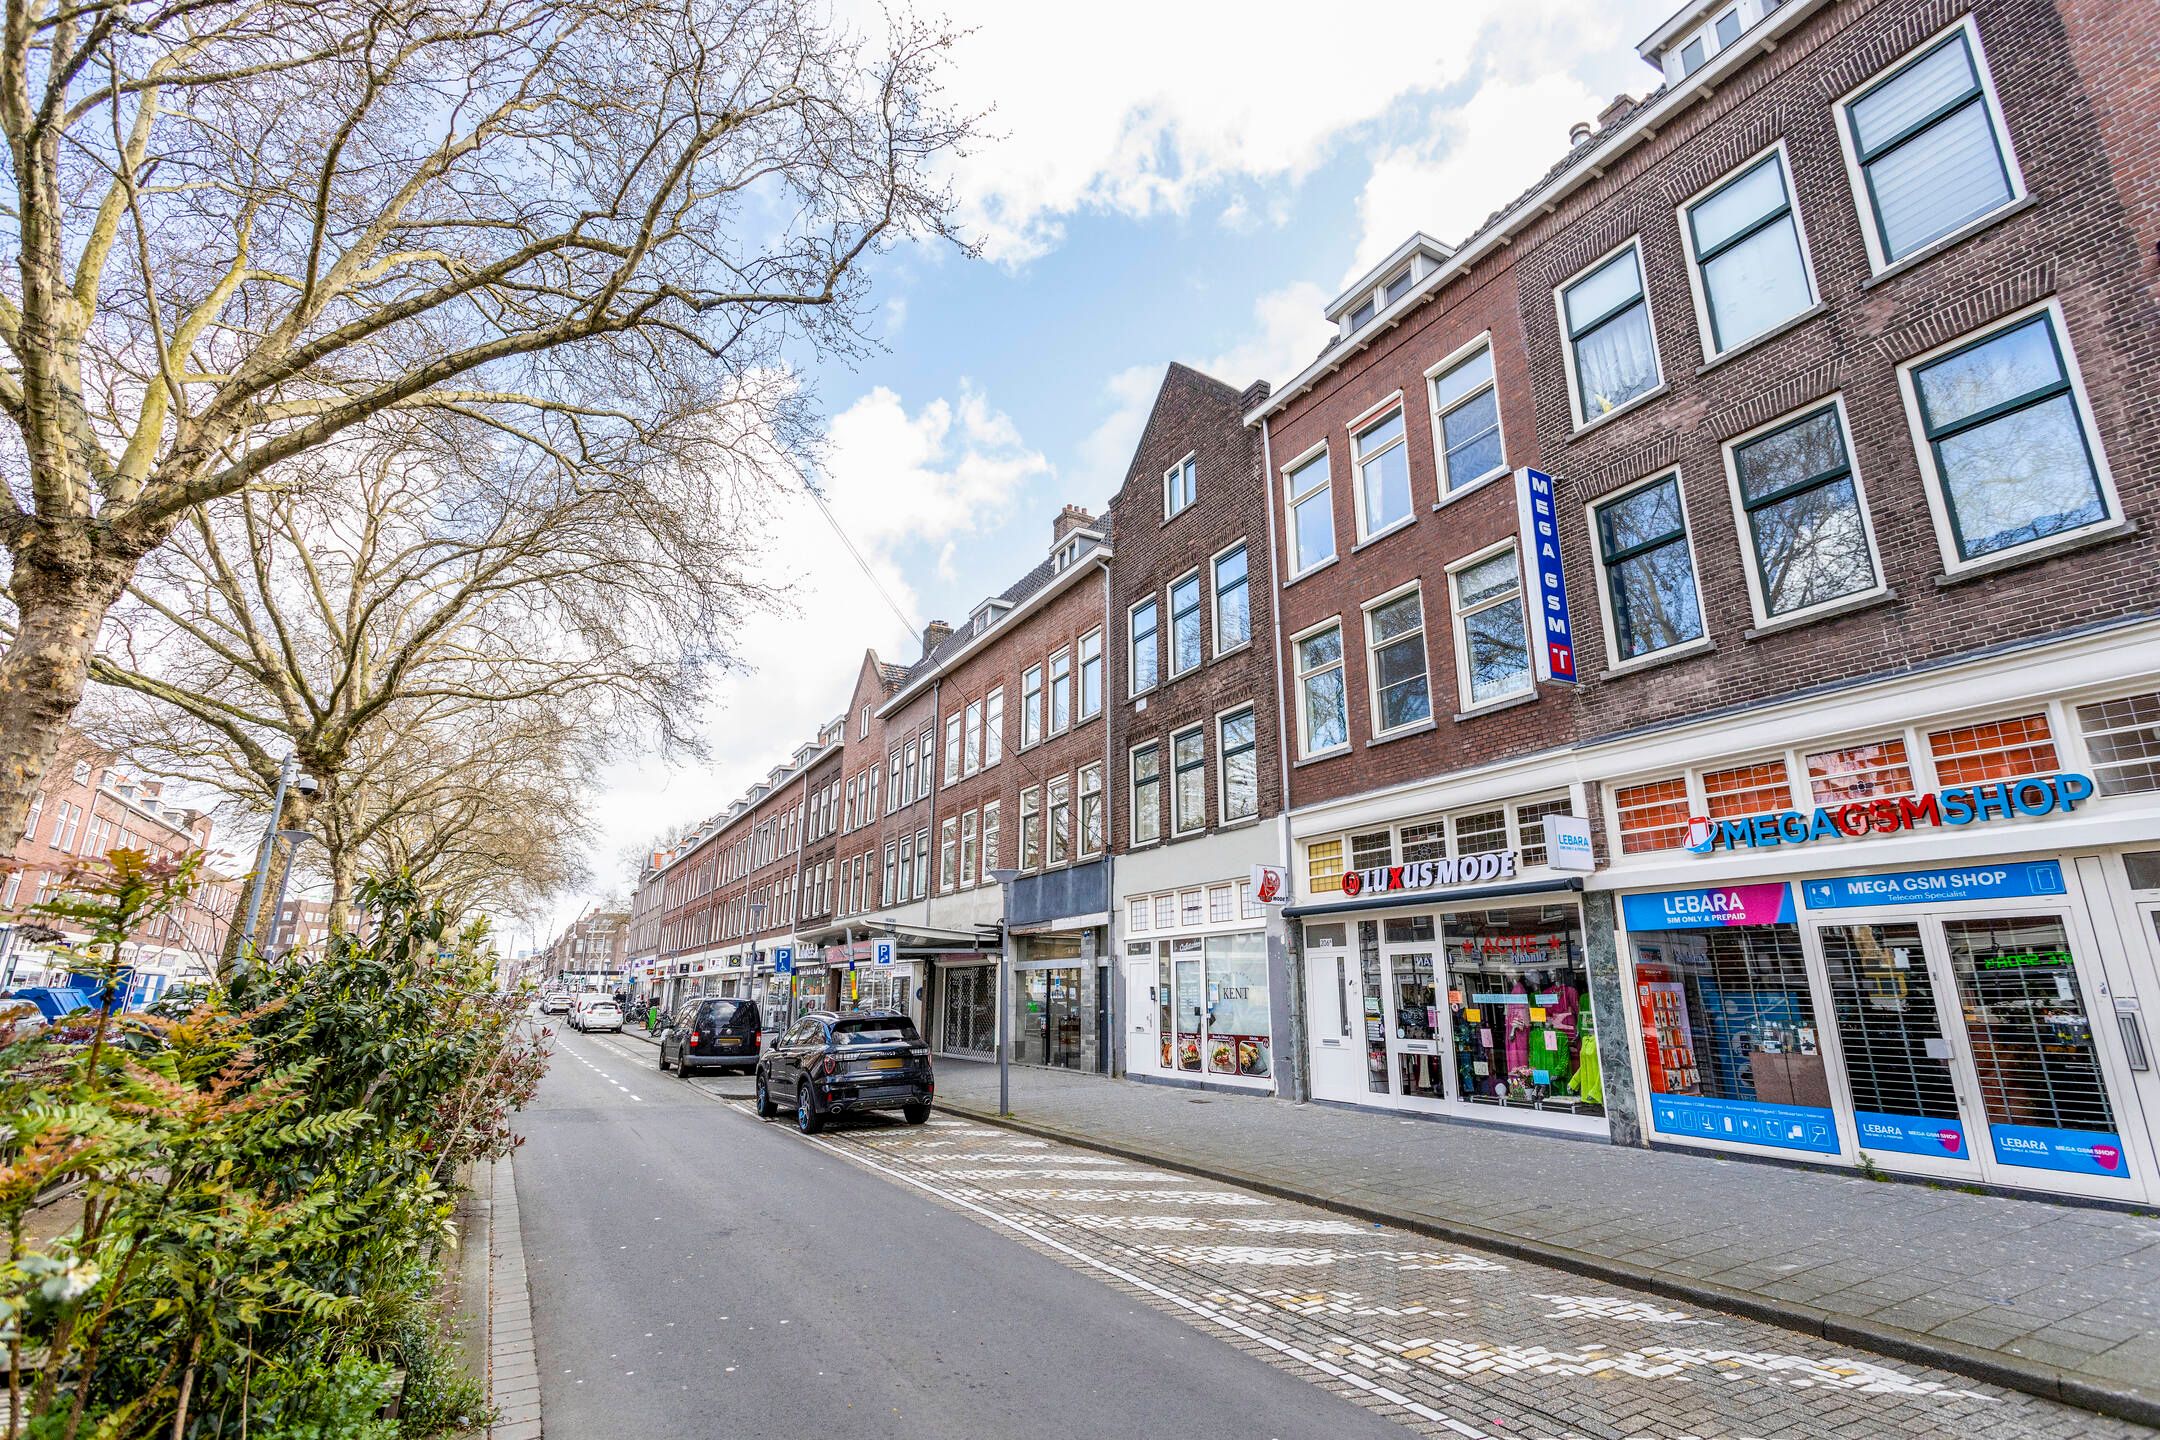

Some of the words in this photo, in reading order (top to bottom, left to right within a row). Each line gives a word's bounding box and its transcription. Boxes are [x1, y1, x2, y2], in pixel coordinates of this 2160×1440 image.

[1531, 476, 1555, 559] MEGA
[1544, 572, 1566, 635] GSM
[1558, 833, 1589, 847] LEBARA
[1847, 879, 1901, 895] MEGA
[1902, 875, 1947, 891] GSM
[1949, 871, 2007, 888] SHOP
[1887, 893, 1923, 901] Telecom
[1924, 890, 1967, 901] Specialist
[1663, 892, 1745, 915] LEBARA
[1681, 915, 1702, 923] ONLY
[1711, 912, 1746, 921] PREPAID
[1482, 933, 1538, 954] ACTIE
[779, 950, 788, 963] P
[880, 945, 888, 956] P
[1223, 987, 1250, 999] KENT
[1862, 1123, 1903, 1136] LEBARA
[1999, 1136, 2049, 1151] LEBARA
